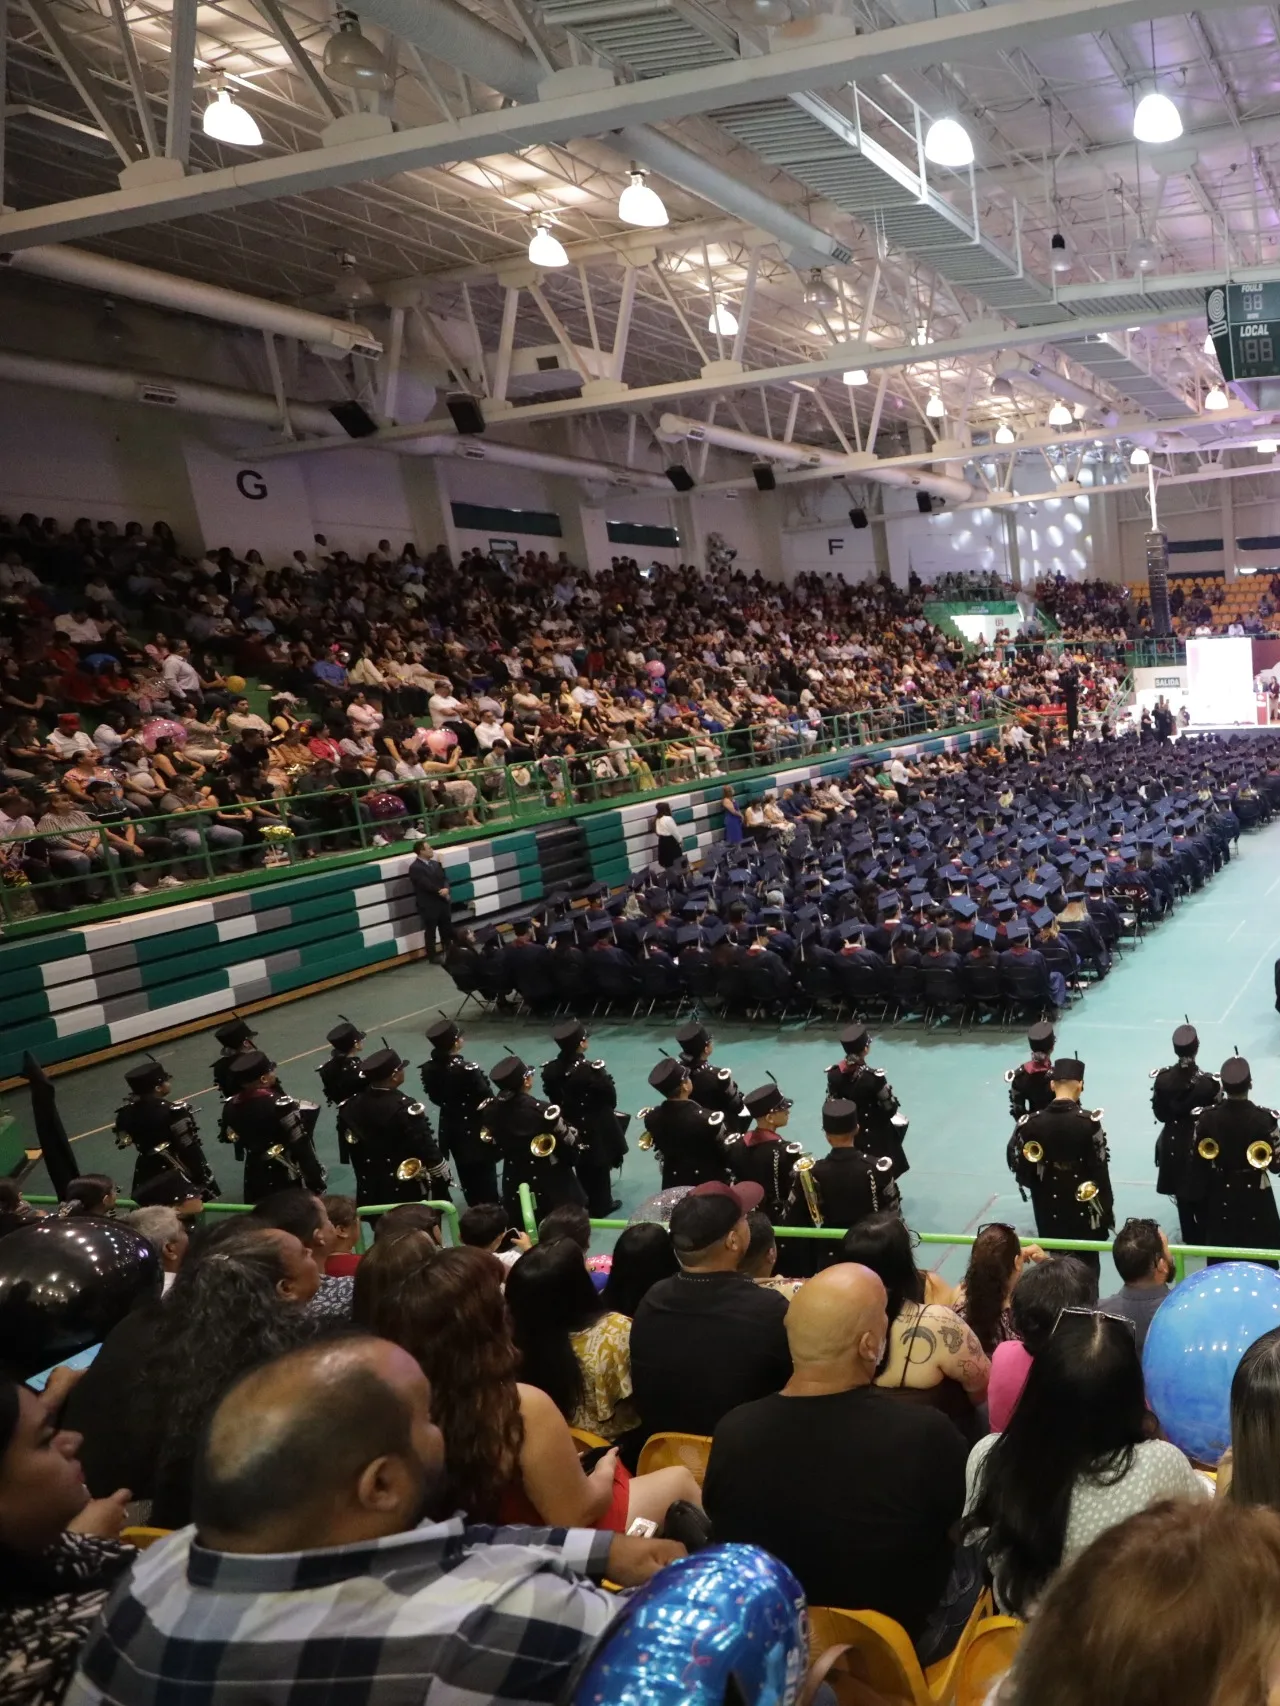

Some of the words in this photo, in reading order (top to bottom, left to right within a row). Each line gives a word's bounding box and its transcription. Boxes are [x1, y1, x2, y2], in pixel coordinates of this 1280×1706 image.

[1241, 283, 1263, 293] FOULS
[1240, 324, 1269, 337] LOCAL
[236, 469, 268, 500] G
[828, 538, 844, 555] F
[1156, 678, 1180, 687] SALIDA
